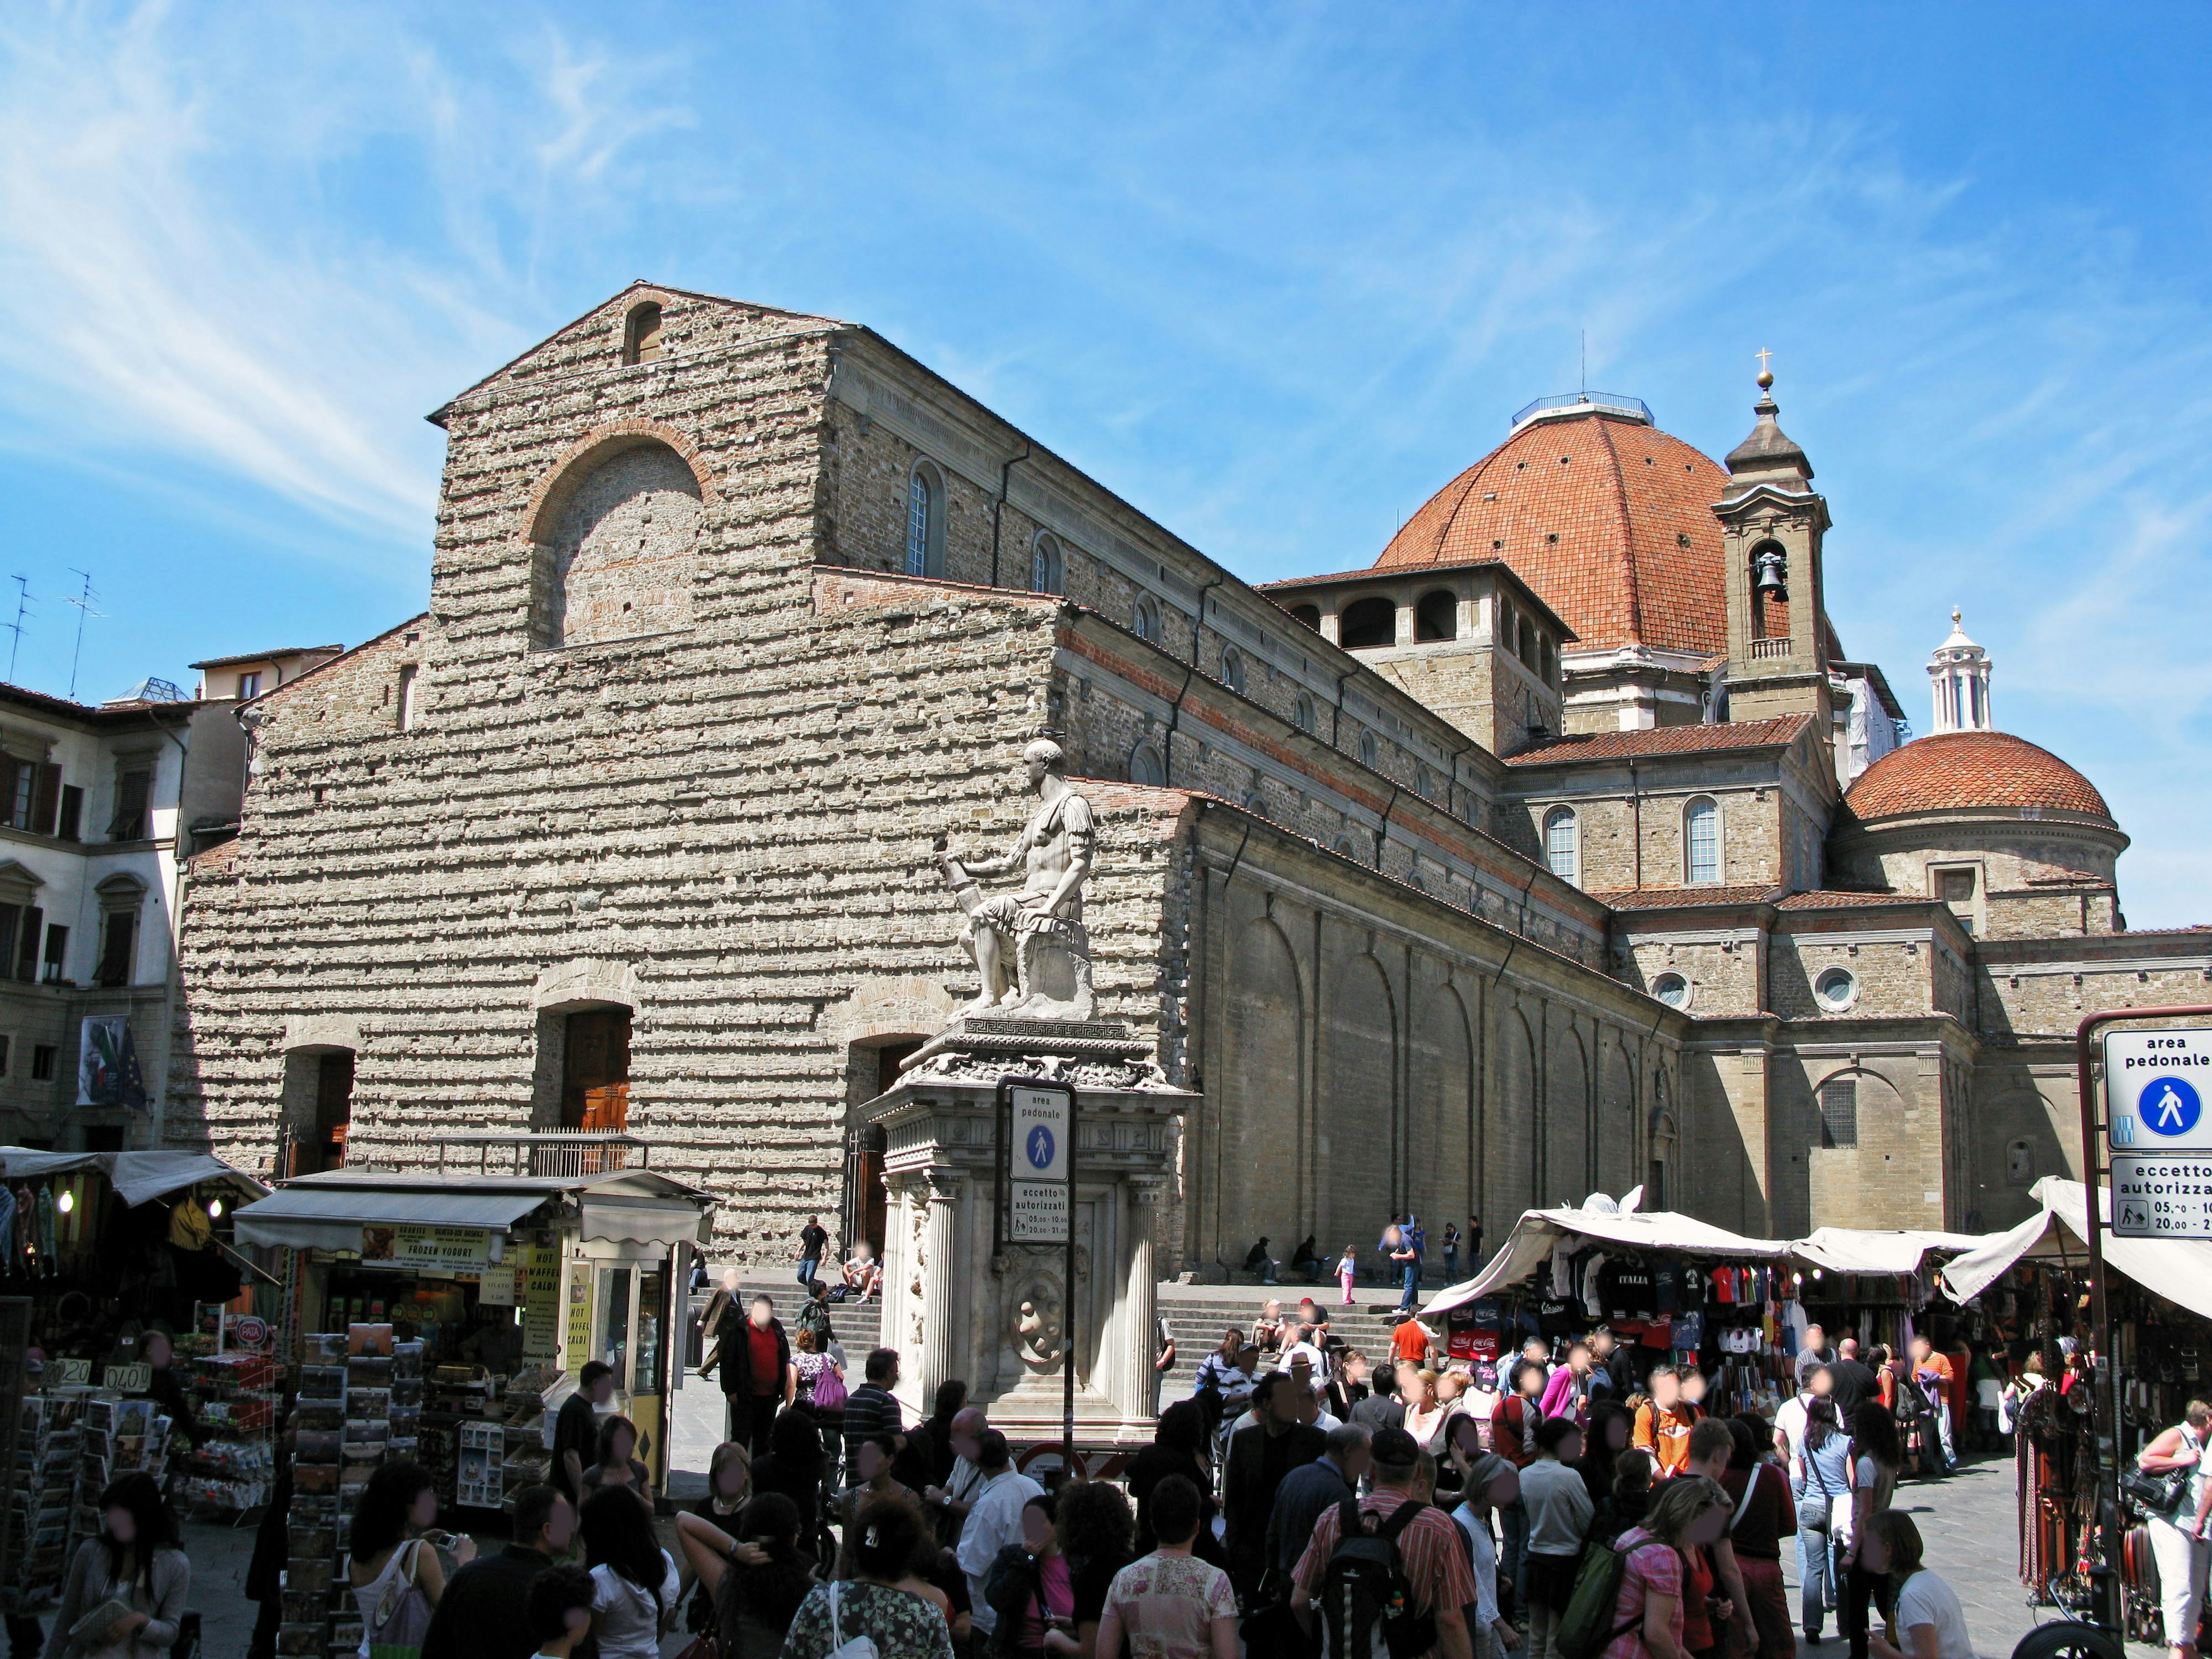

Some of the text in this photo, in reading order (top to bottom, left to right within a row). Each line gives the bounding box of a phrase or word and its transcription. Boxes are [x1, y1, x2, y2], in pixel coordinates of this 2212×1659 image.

[2147, 1038, 2186, 1048] area
[2125, 1053, 2210, 1069] pedonale
[1032, 1097, 1050, 1105] area
[1021, 1108, 1060, 1119] pedonale
[2135, 1165, 2212, 1177] eccetto
[1023, 1188, 1058, 1197] eccetto
[1016, 1200, 1065, 1210] autorizzati
[2156, 1218, 2187, 1230] 20,00
[408, 1245, 472, 1257] FROZEN YOGURT
[536, 1253, 553, 1263] HOT
[529, 1268, 560, 1277] WAFFEL
[1619, 1275, 1648, 1285] ITALIA
[531, 1281, 556, 1291] CALDI
[571, 1308, 584, 1317] HOT
[241, 1326, 259, 1337] PATA
[567, 1335, 586, 1344] CALDI
[107, 1368, 138, 1391] 0,40
